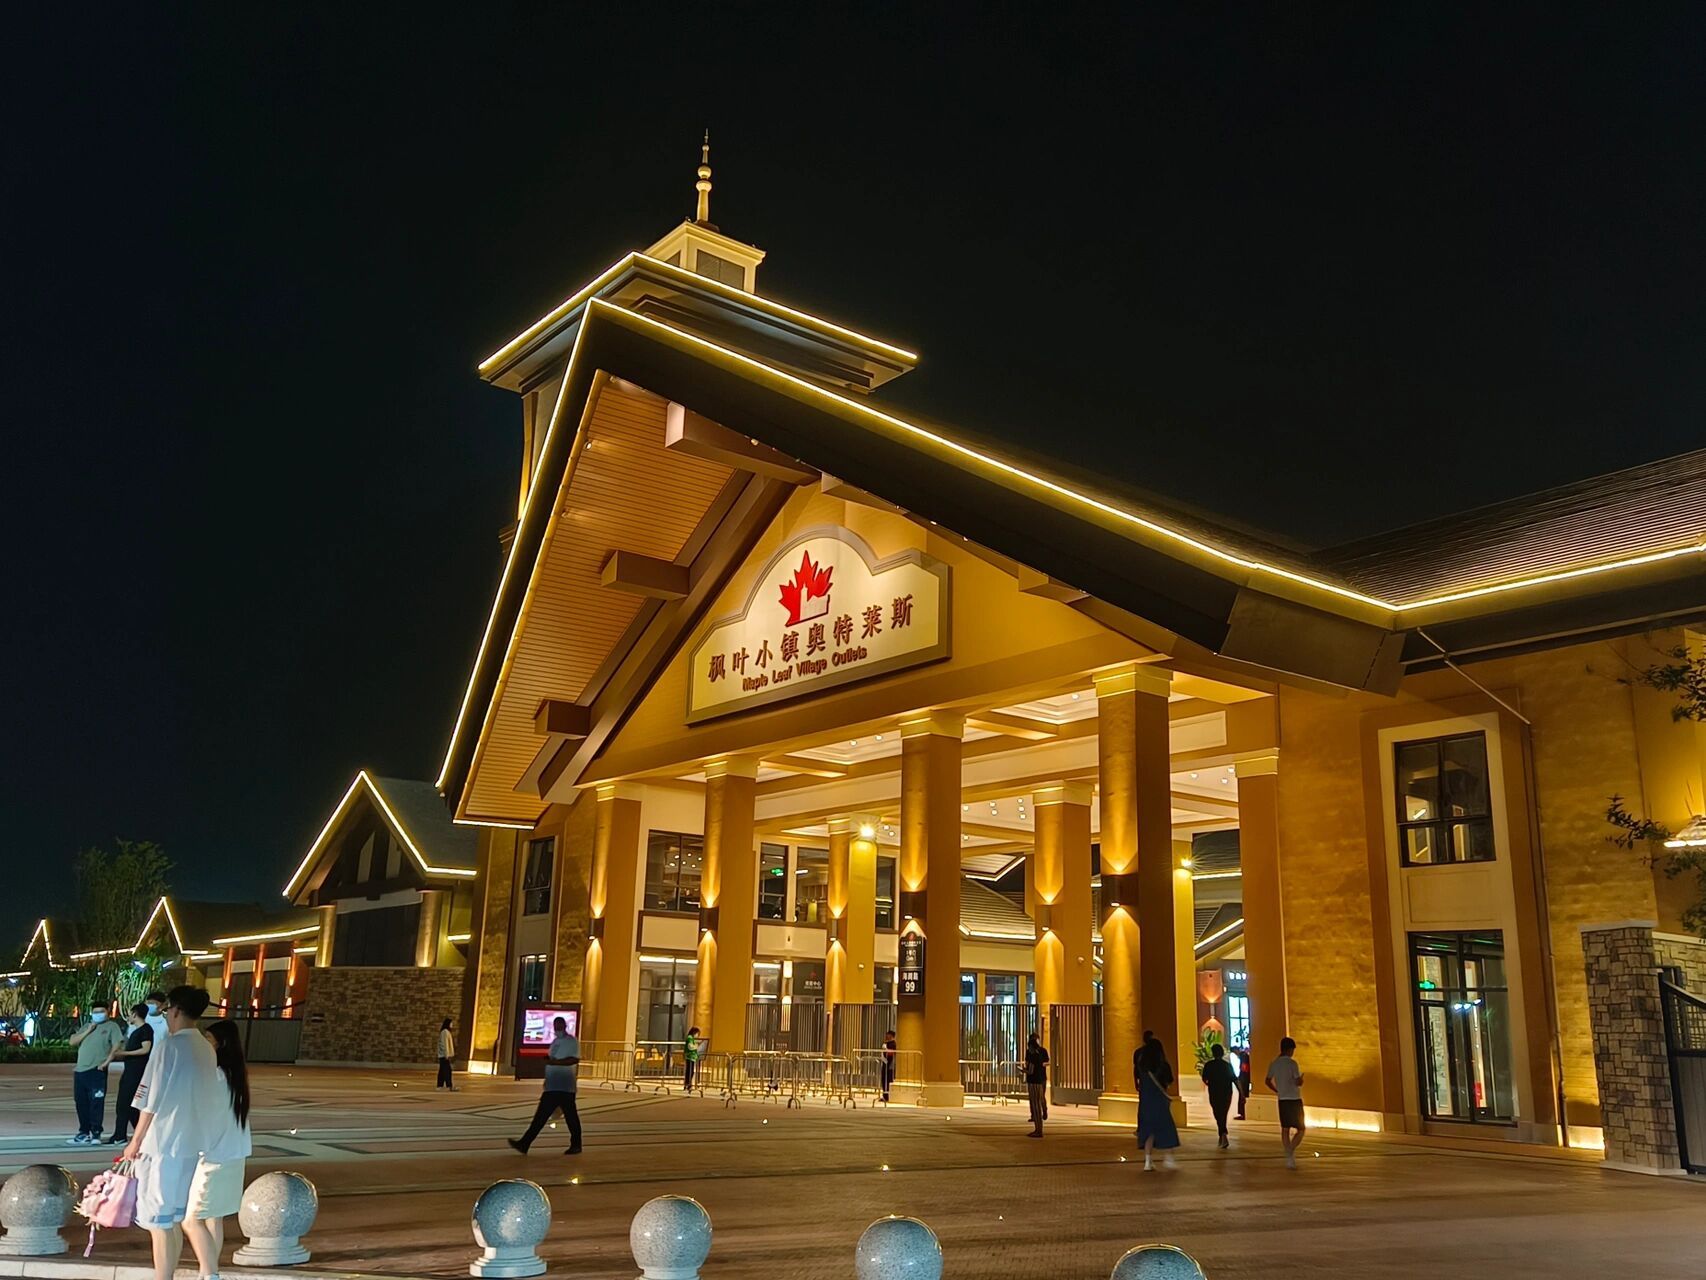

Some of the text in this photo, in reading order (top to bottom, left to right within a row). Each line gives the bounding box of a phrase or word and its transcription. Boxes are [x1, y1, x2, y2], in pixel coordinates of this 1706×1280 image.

[708, 594, 914, 682] 枫叶小镇奥特莱斯
[742, 646, 867, 692] Maple Leaf Village Outlets
[905, 981, 915, 992] 99
